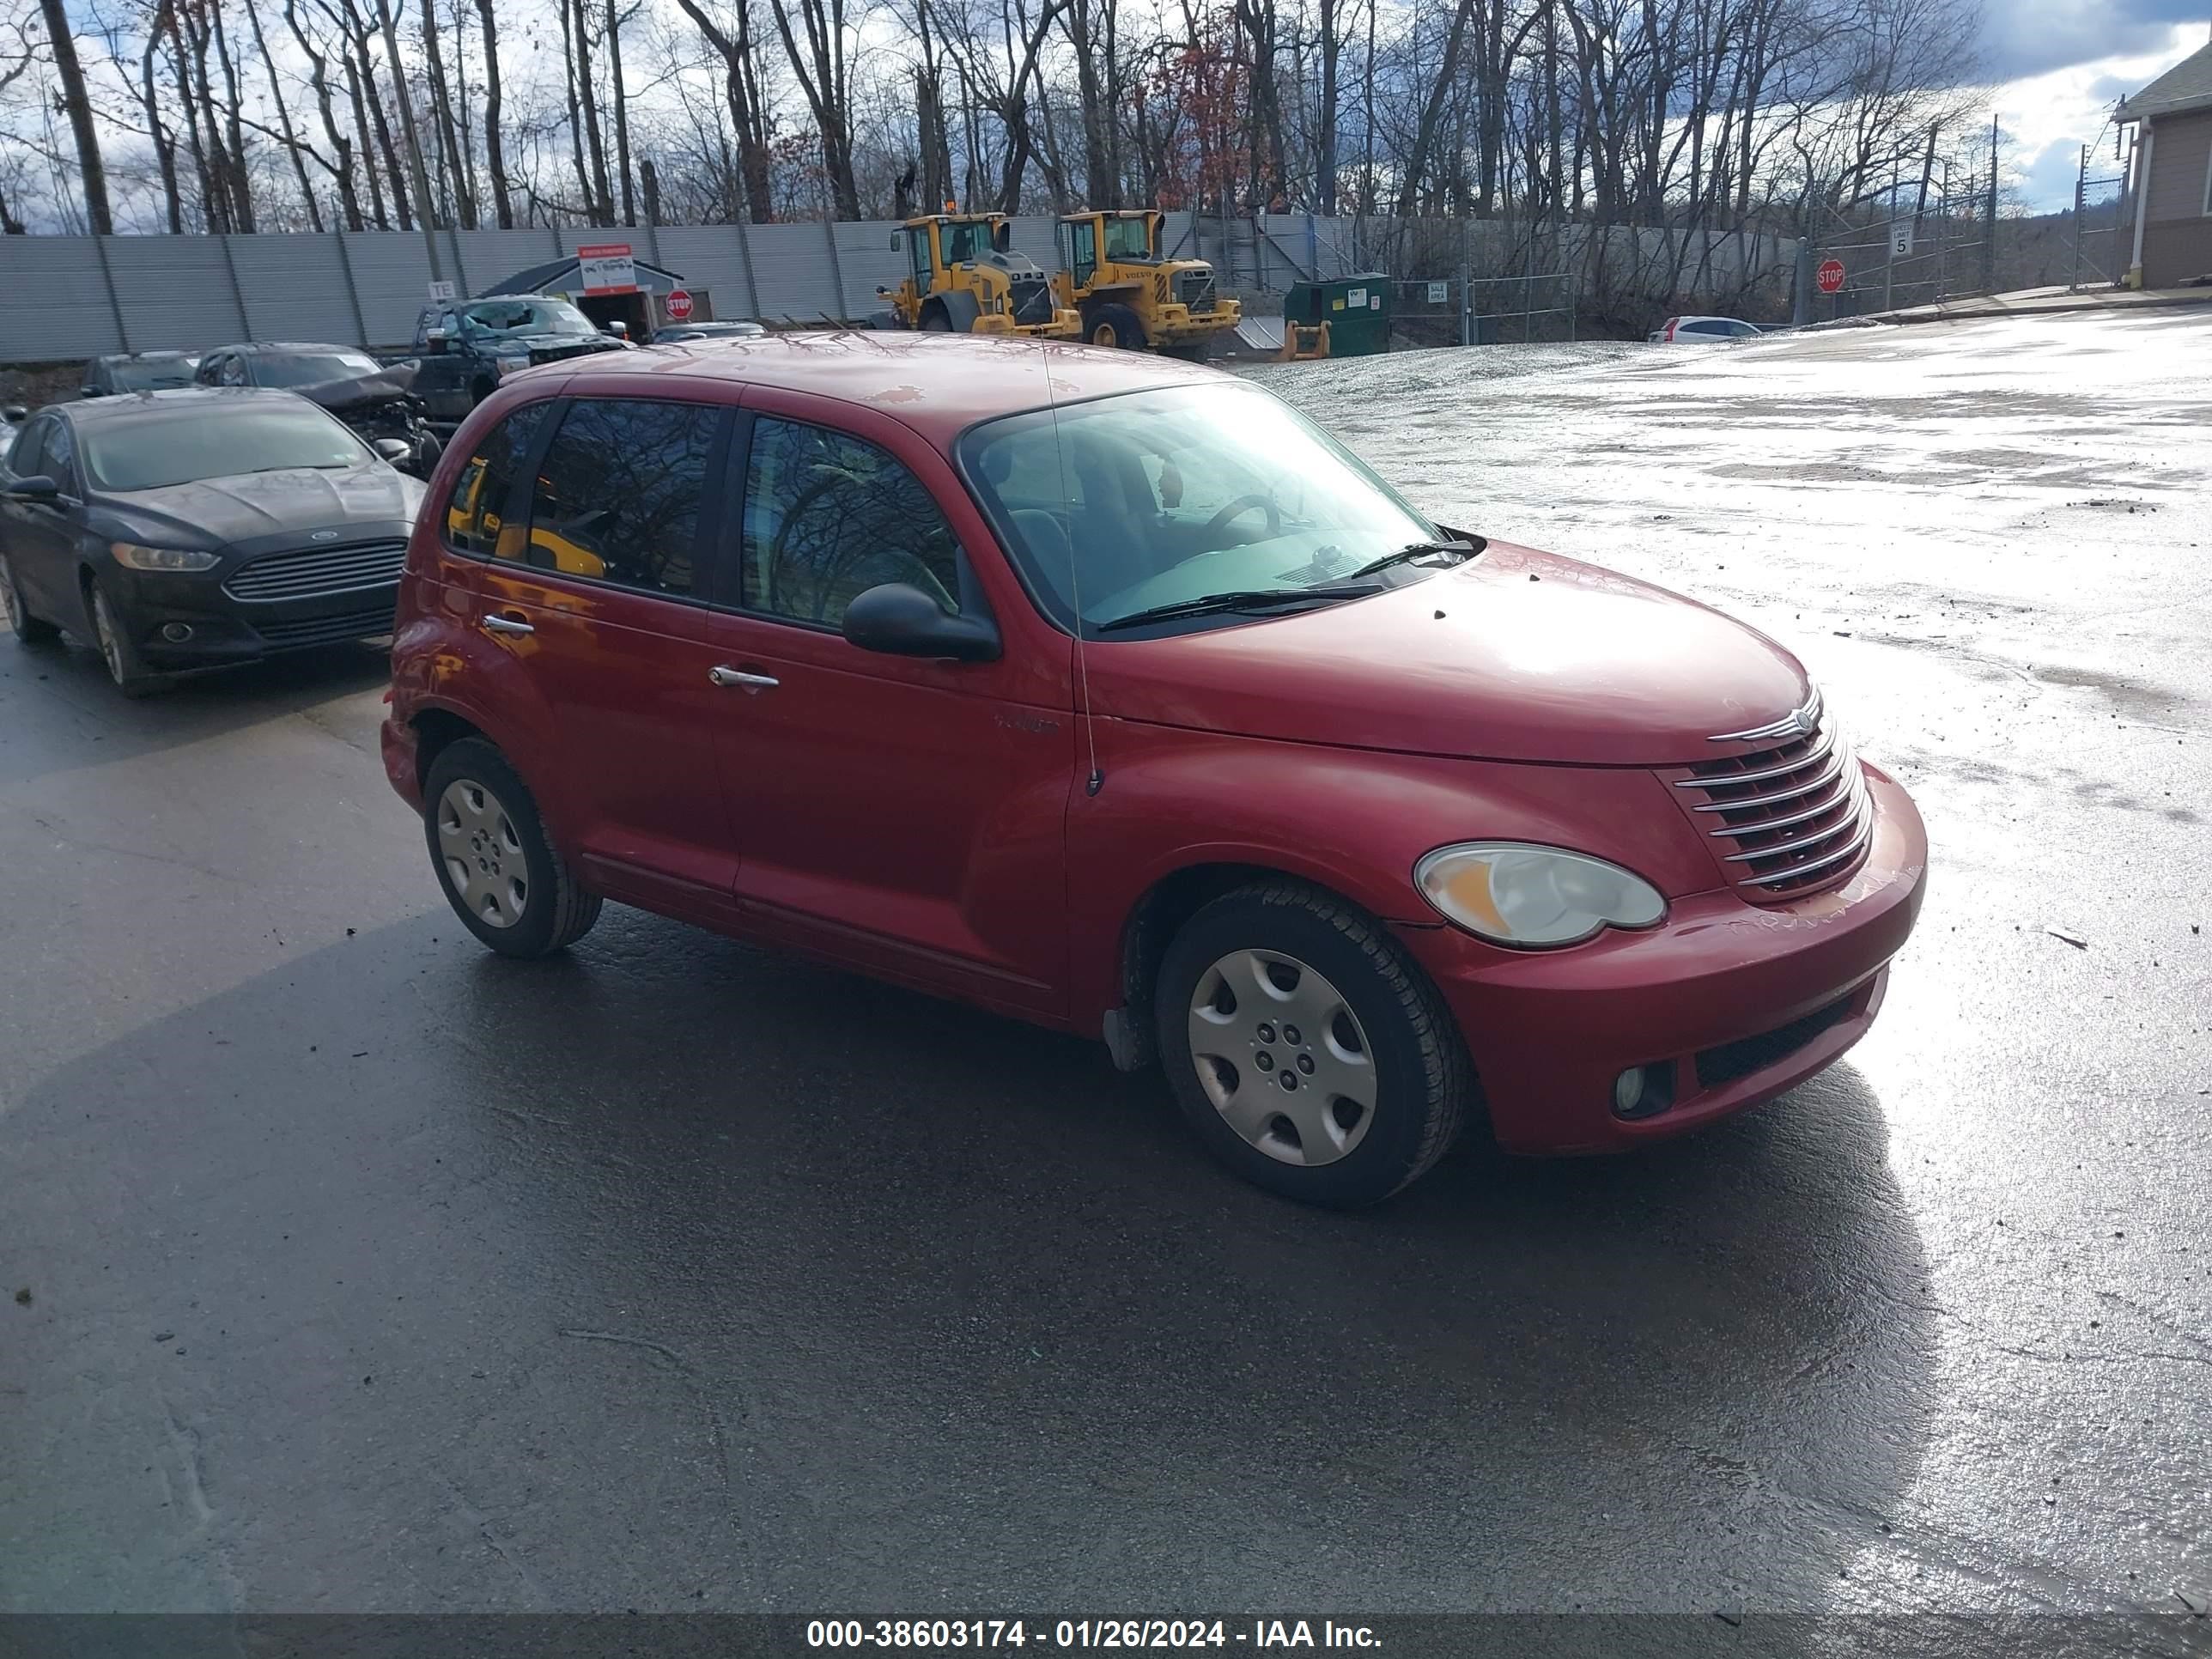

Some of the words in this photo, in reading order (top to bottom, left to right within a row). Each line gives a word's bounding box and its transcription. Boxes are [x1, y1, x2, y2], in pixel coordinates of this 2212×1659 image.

[1897, 240, 1906, 252] 5
[1819, 268, 1843, 283] STOP
[669, 298, 690, 310] STOP
